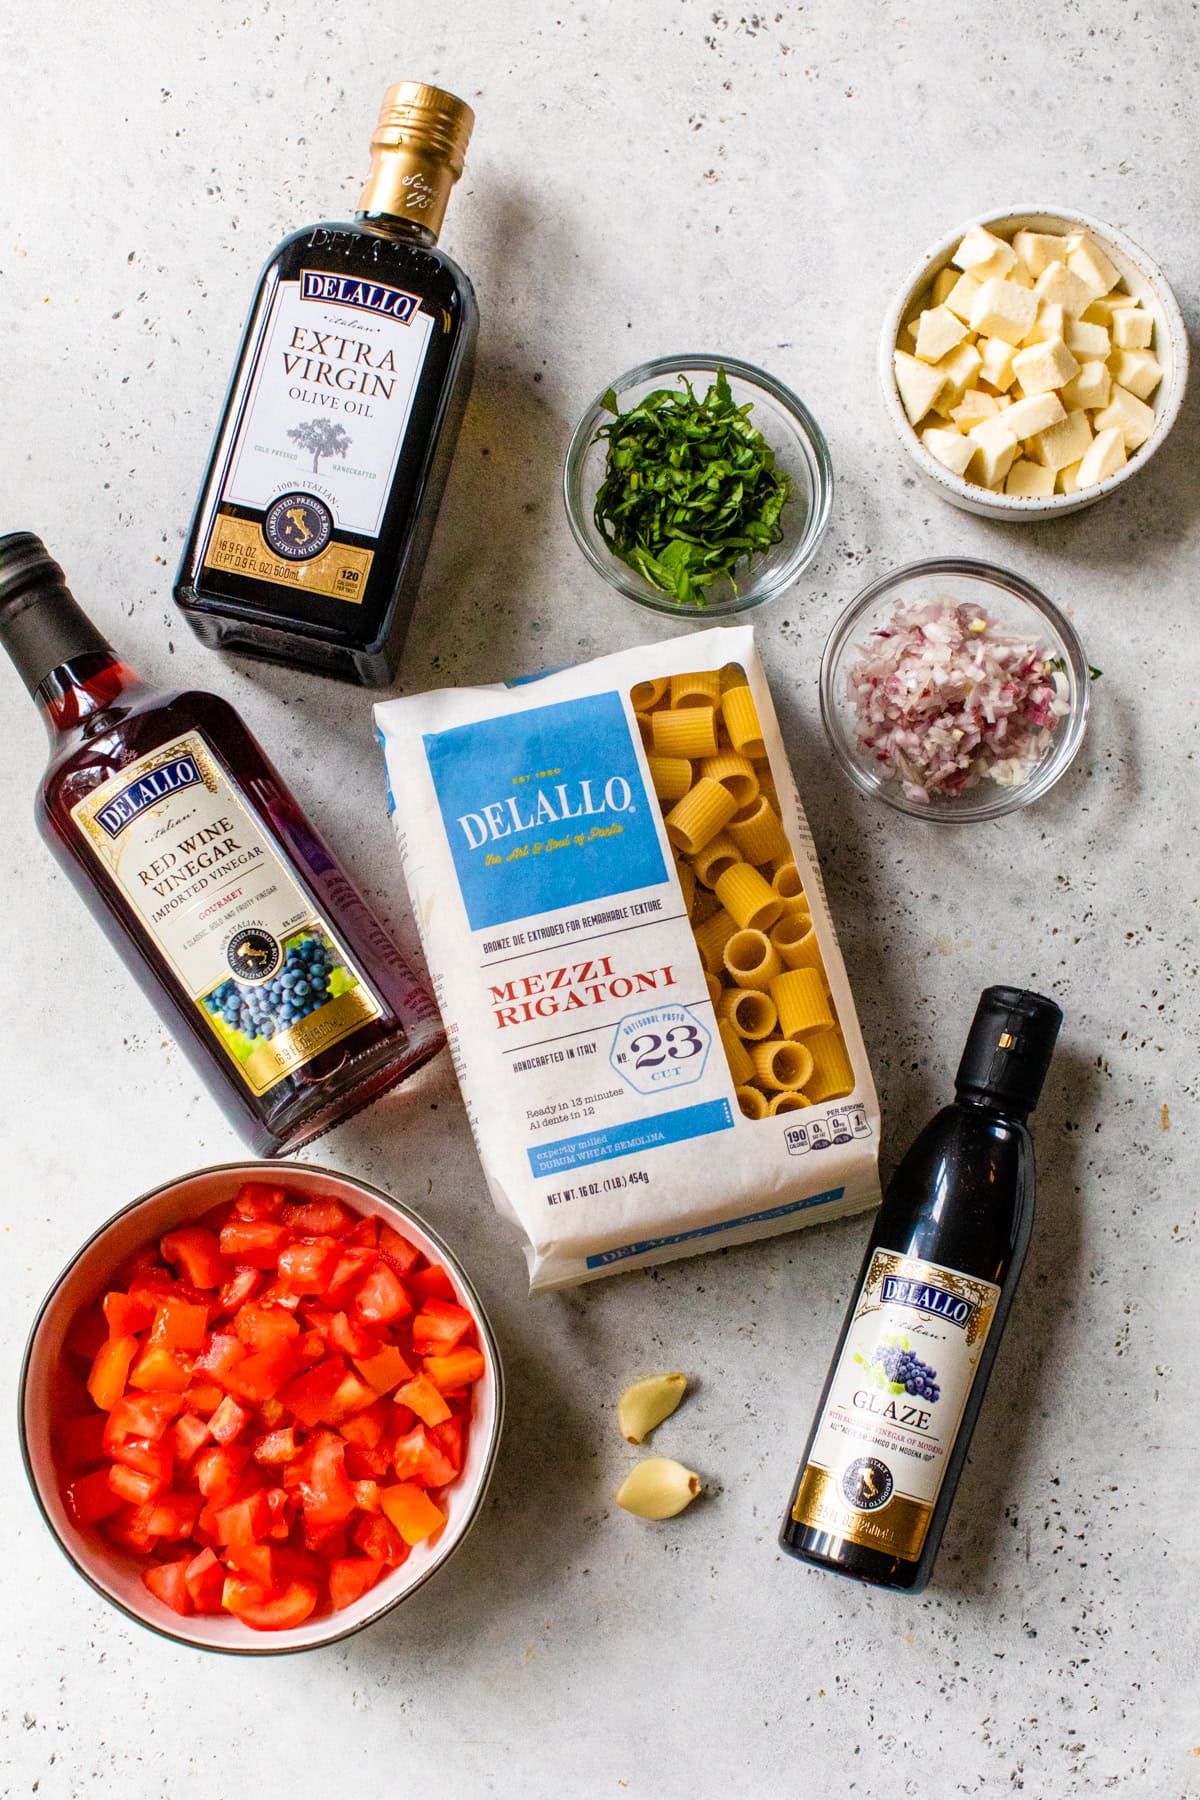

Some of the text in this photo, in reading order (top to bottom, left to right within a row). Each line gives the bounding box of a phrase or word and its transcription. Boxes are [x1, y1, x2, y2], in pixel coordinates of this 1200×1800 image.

[306, 274, 412, 320] DELALLO
[288, 326, 398, 373] EXTRA
[282, 352, 398, 400] VIRGIN
[288, 387, 374, 418] OLIVE OIL
[223, 553, 234, 564] PT
[248, 559, 257, 571] FL
[235, 542, 244, 553] FL
[245, 546, 257, 558] OZ
[275, 541, 296, 555] ITALY
[341, 569, 359, 582] 120
[99, 761, 198, 833] DELALLO
[456, 776, 632, 851] DELALLO
[137, 816, 234, 887] RED WINE
[484, 853, 502, 867] the
[545, 833, 571, 853] Soul
[573, 831, 585, 846] of
[587, 822, 624, 842] Pasta
[151, 845, 264, 924] IMPORTED VINEGAR
[152, 836, 242, 897] VINEGAR
[198, 887, 244, 921] GOURMET
[482, 899, 663, 954] BRONZE DIE EXTRUDED FOR REMARKABLE TEXTURE
[487, 956, 617, 1006] MEZZI
[494, 965, 679, 1030] RIGATONI
[512, 1042, 598, 1073] HANDCRAFTED IN ITALY
[630, 1024, 703, 1070] 23
[650, 1066, 682, 1082] CUT
[526, 1087, 625, 1121] Ready in 13 minutes
[529, 1106, 595, 1131] Al dente in 12
[826, 1102, 865, 1117] PER SERVING
[536, 1134, 608, 1161] expertly milled
[538, 1131, 666, 1172] DURUM WHEAT SEMOLINA
[787, 1129, 807, 1144] 190
[547, 1170, 650, 1207] NET WT. 16 OZ. (1 LB.) 454g
[884, 1280, 969, 1322] DELALLO
[852, 1390, 932, 1431] GLAZE
